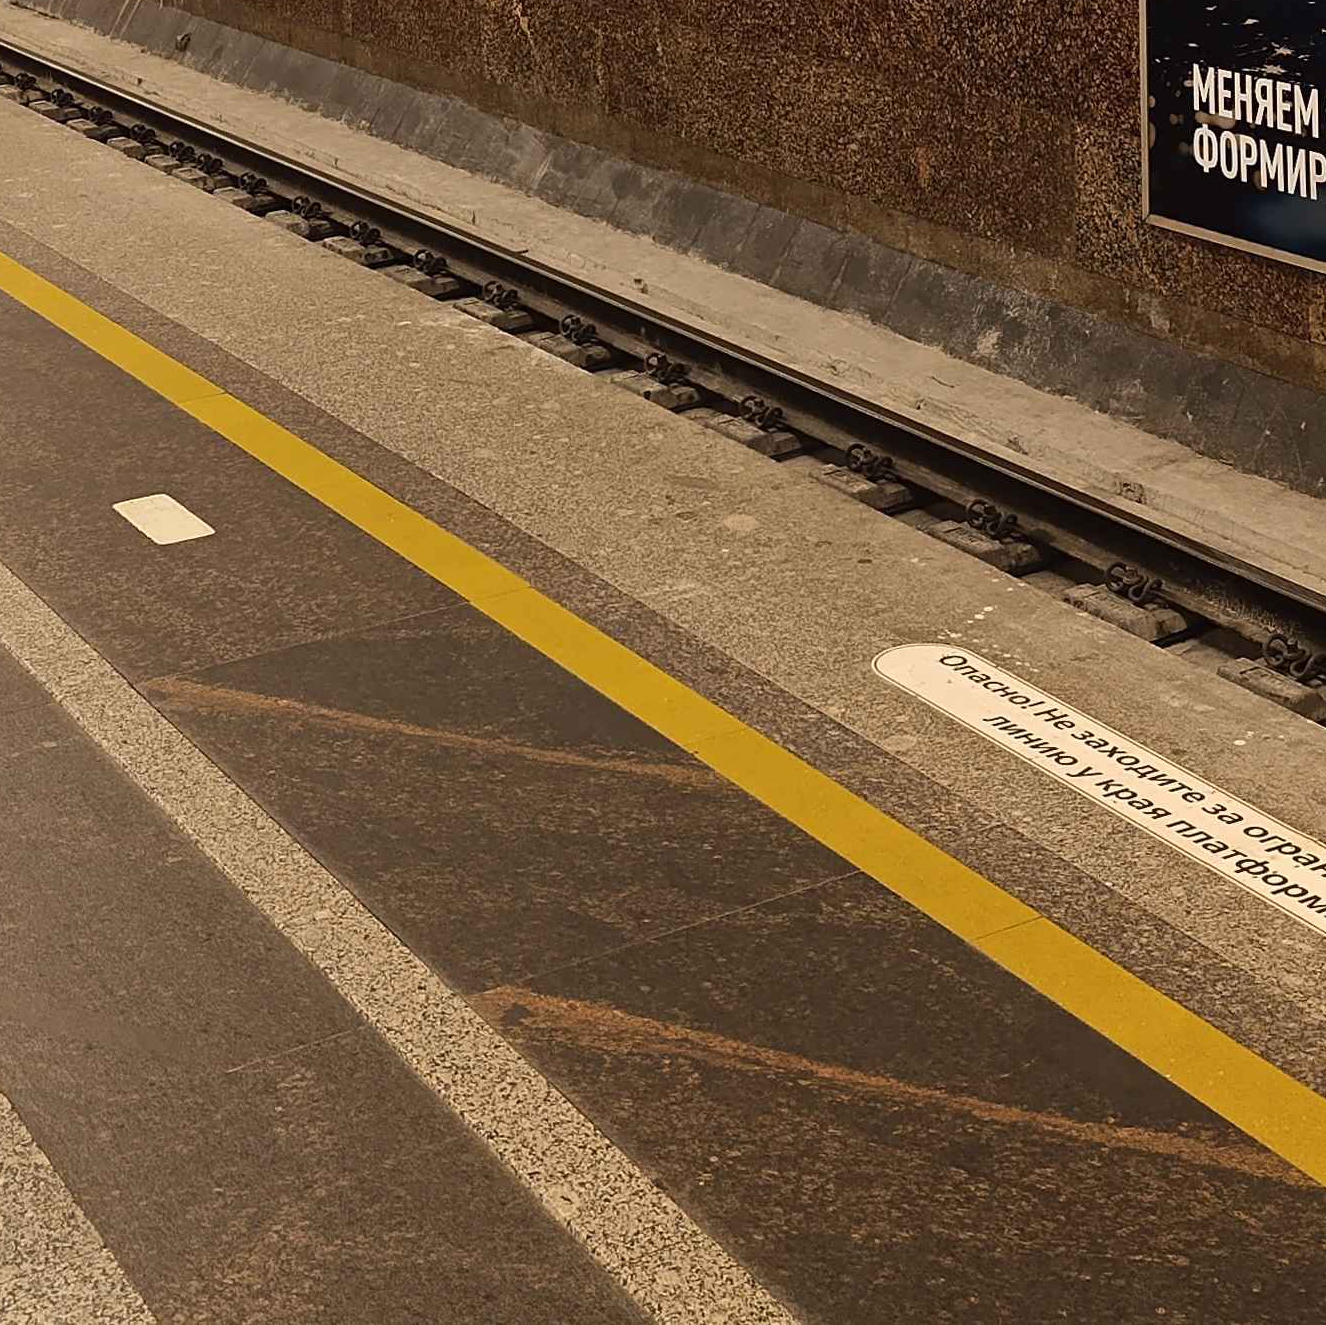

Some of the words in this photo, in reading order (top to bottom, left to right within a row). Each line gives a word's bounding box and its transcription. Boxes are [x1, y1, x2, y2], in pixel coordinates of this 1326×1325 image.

[1192, 63, 1320, 139] МЕНЯЕМ
[938, 653, 1044, 710] Опасно!
[1033, 707, 1076, 730] Не
[1072, 725, 1208, 804] заходите
[1201, 800, 1244, 826] за
[983, 712, 1078, 767] линию
[1071, 765, 1103, 780] у
[1095, 778, 1173, 821] края
